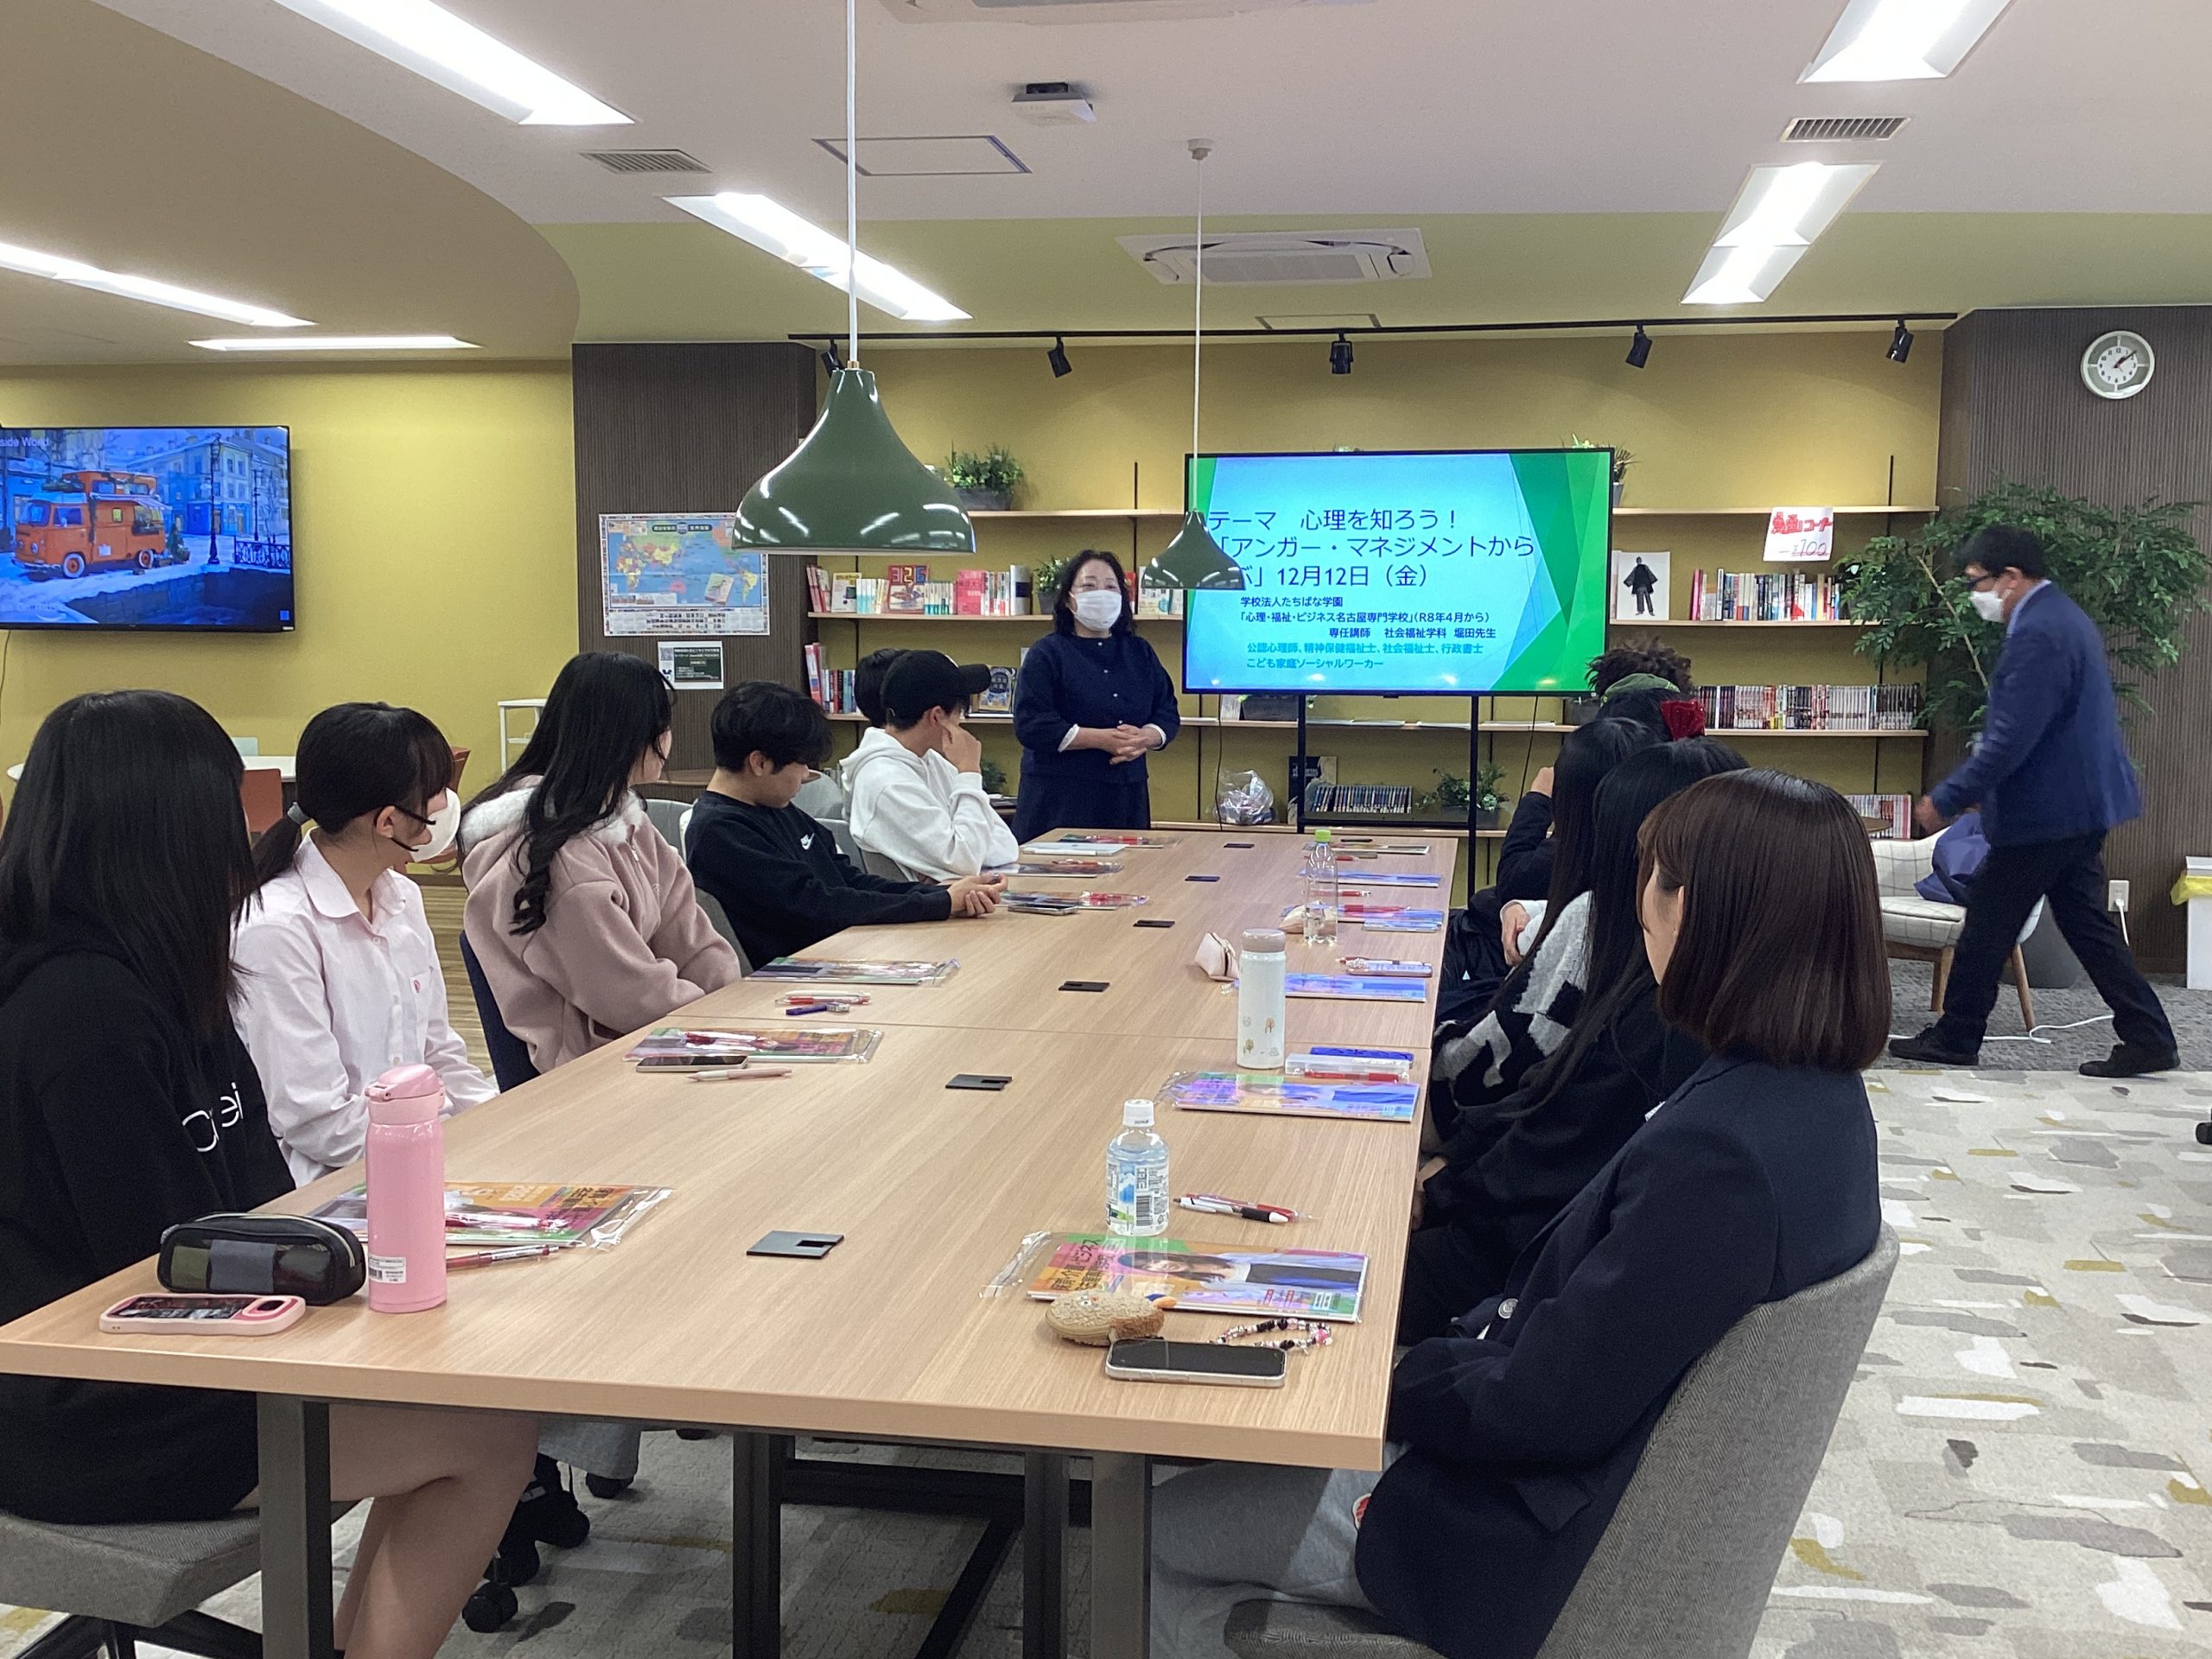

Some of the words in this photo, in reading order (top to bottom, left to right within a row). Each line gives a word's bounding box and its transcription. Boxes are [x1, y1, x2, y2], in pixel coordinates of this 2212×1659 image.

[1209, 511, 1277, 531] テーマ
[1300, 508, 1455, 531] 心理を知ろう！
[1240, 596, 1343, 607] 学校法人たちばな学園
[1329, 627, 1371, 639] 専任講師
[1384, 627, 1447, 639] 社会福祉学科
[1247, 658, 1384, 669] こども家庭ソーシャルワーカー
